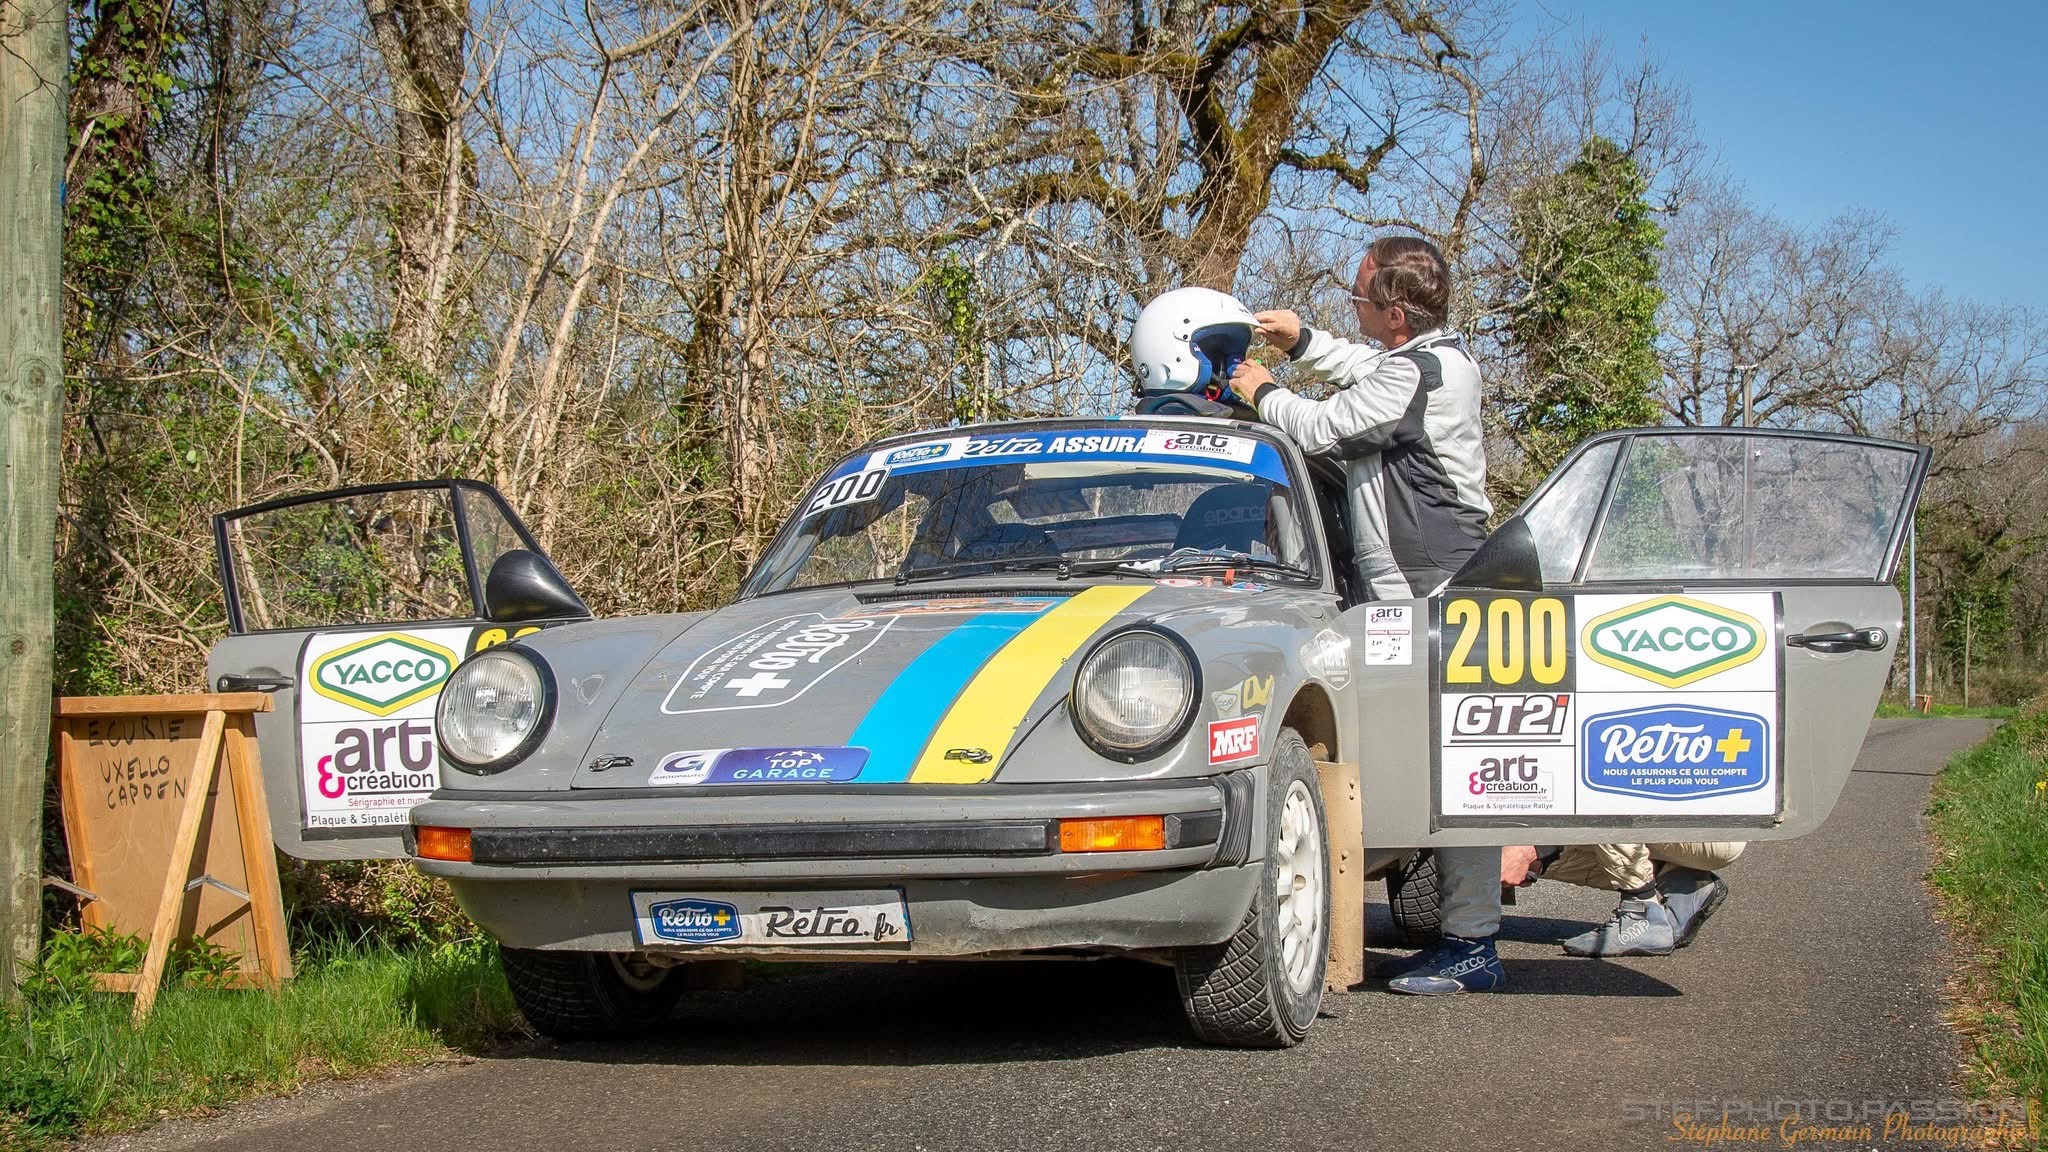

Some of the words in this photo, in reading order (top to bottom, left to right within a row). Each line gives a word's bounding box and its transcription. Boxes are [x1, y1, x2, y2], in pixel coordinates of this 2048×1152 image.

[1175, 433, 1229, 448] art
[805, 469, 887, 516] 200
[1376, 607, 1403, 618] art
[1446, 597, 1567, 685] 200
[1611, 626, 1738, 652] YACCO
[334, 658, 436, 685] YACCO
[1452, 694, 1570, 736] GT2i
[88, 717, 185, 747] ECURIE
[1212, 724, 1257, 758] MRF
[334, 719, 433, 775] art
[100, 755, 170, 785] UXELLO
[733, 768, 834, 779] GARAGE
[770, 759, 812, 769] TOP
[1479, 754, 1538, 782] art
[1603, 768, 1628, 776] NOUS
[1630, 768, 1677, 776] ASSURONS
[1679, 768, 1691, 776] CE
[1693, 768, 1709, 777] QUI
[1711, 768, 1748, 776] COMPTE
[348, 796, 395, 808] Sérigraphie
[1463, 802, 1485, 811] Plaque
[1533, 802, 1553, 811] Rallye
[311, 815, 347, 827] Plaque
[350, 814, 358, 824] &
[1618, 919, 1650, 945] OMP
[1440, 955, 1486, 979] sparco
